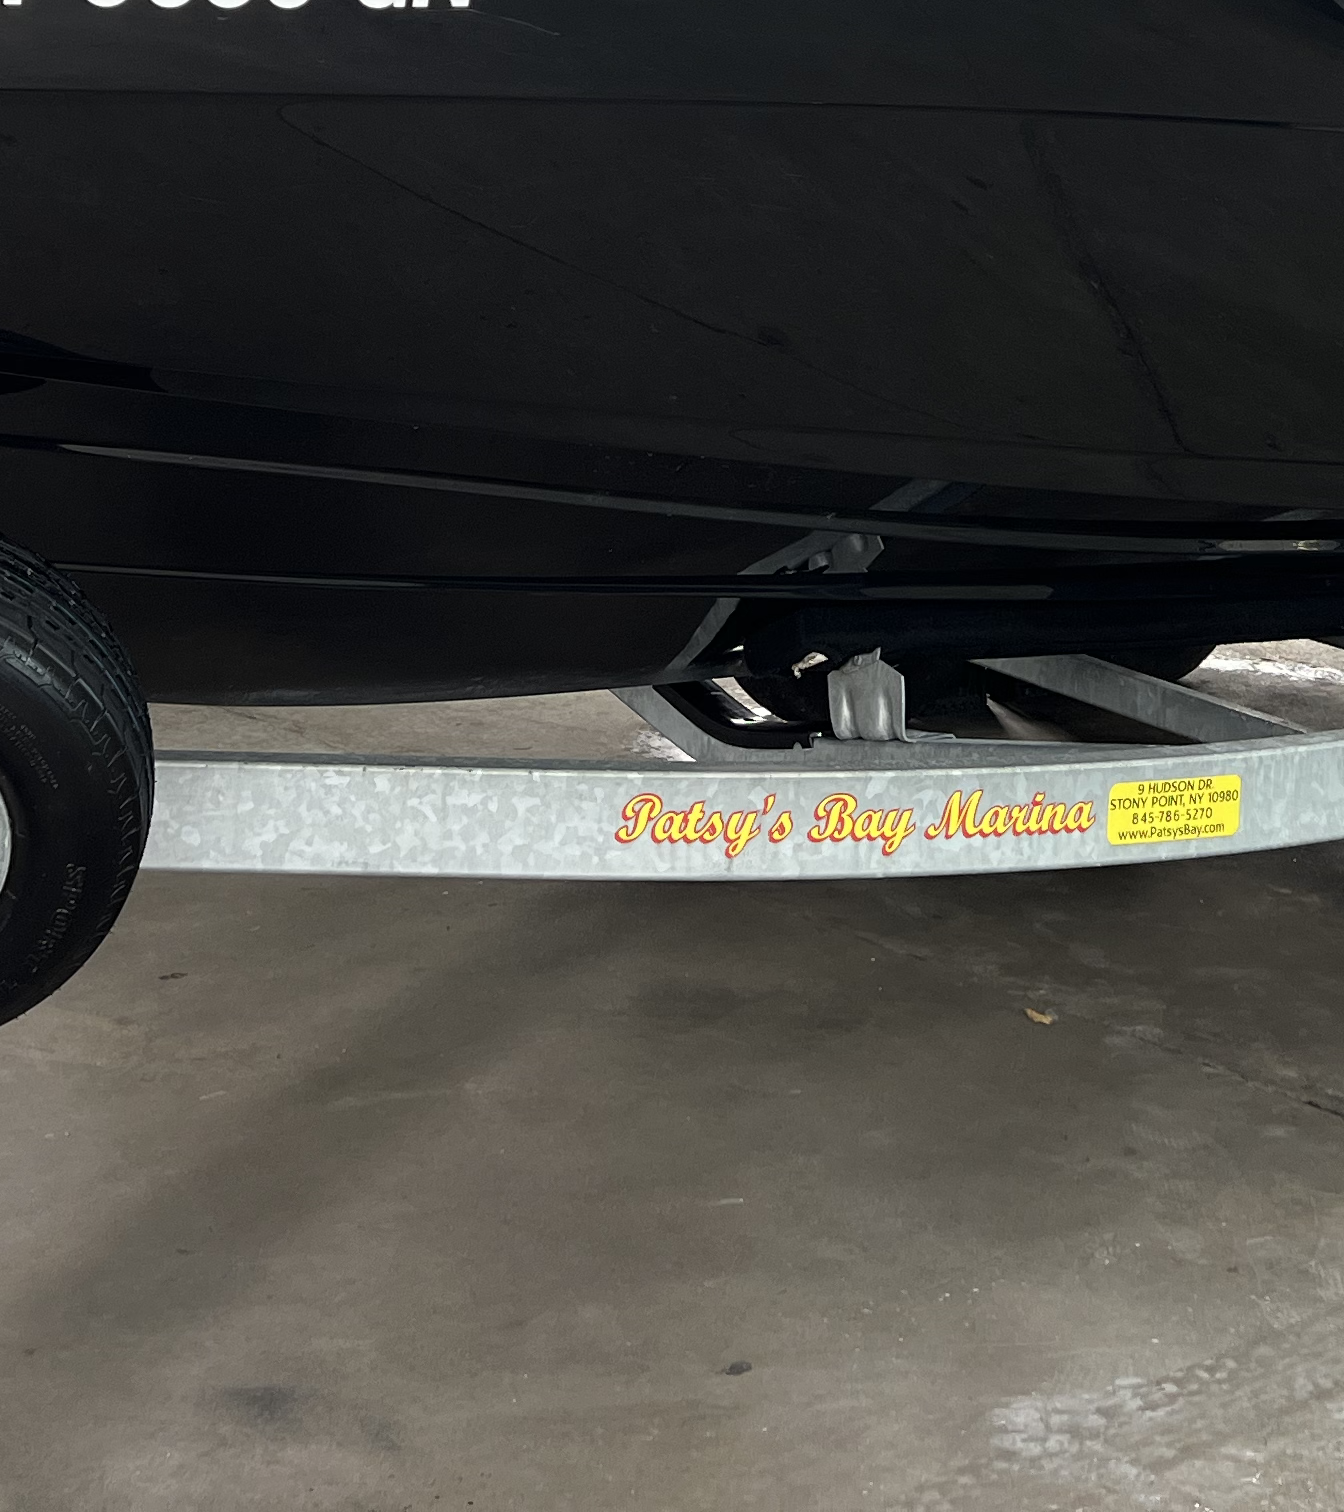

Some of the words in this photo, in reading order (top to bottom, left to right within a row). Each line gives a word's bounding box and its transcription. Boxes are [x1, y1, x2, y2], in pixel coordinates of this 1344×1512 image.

[1138, 784, 1145, 795] 9
[1148, 780, 1195, 795] HUDSON
[1109, 796, 1148, 811] STONY
[1151, 795, 1186, 808] POINT,
[1189, 792, 1205, 805] NY
[1208, 789, 1239, 803] 10980
[614, 791, 794, 859] Patsy's
[807, 792, 916, 856] Bay
[924, 789, 1096, 841] Marina
[1132, 807, 1213, 825] 845-786-5270
[1118, 823, 1225, 841] www.PatsysBay.com
